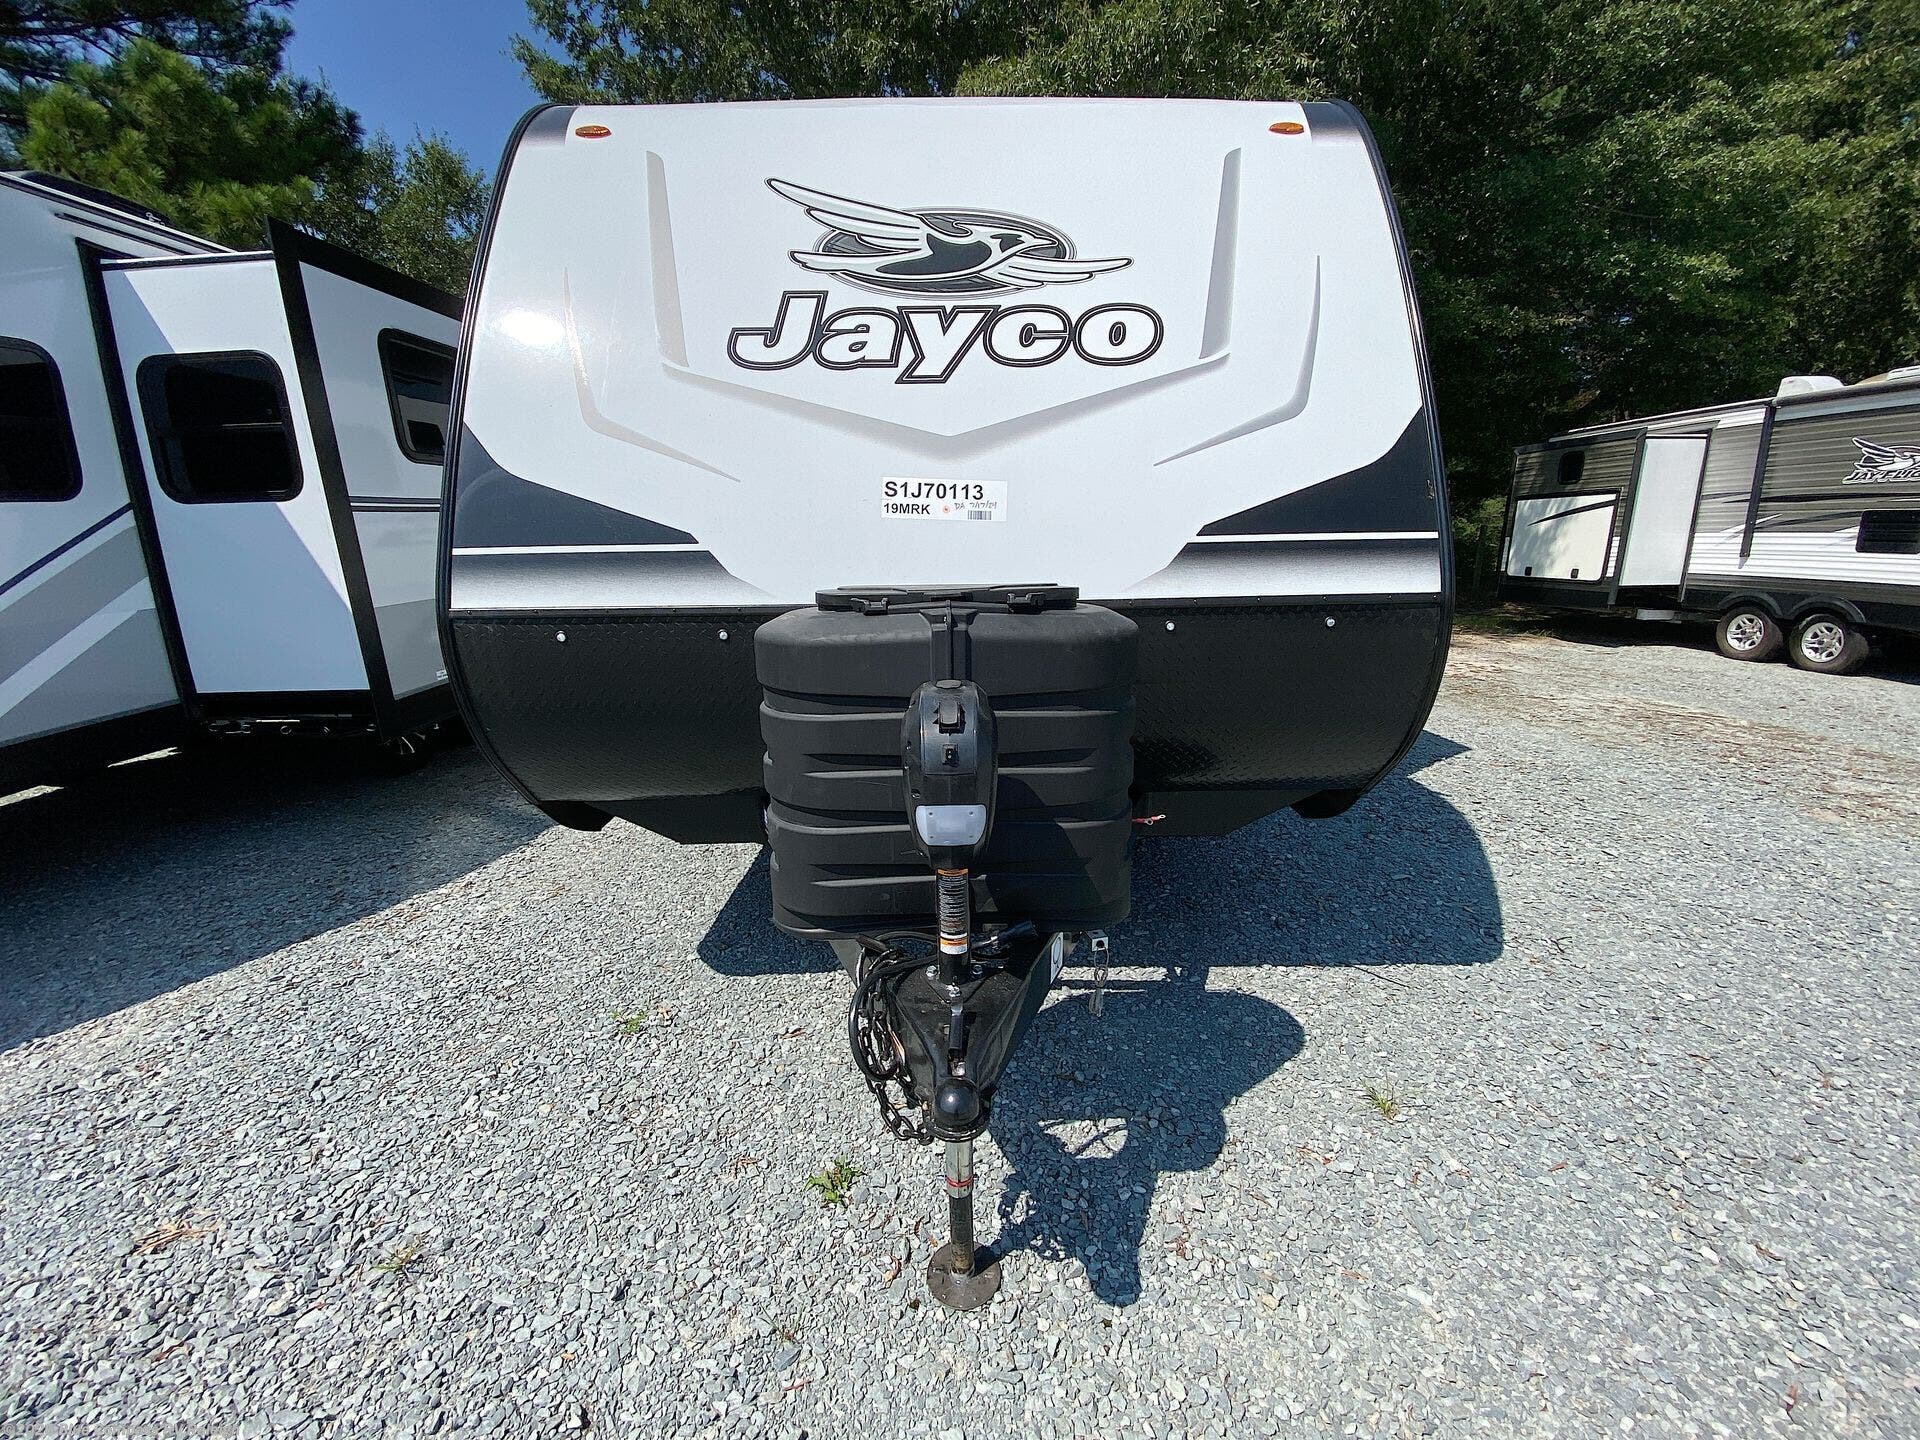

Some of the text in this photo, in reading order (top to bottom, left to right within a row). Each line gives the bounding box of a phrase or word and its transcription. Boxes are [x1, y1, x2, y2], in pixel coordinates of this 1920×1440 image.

[727, 290, 1165, 385] Jayco
[884, 481, 984, 501] S1J70113
[883, 502, 931, 515] 19MRK
